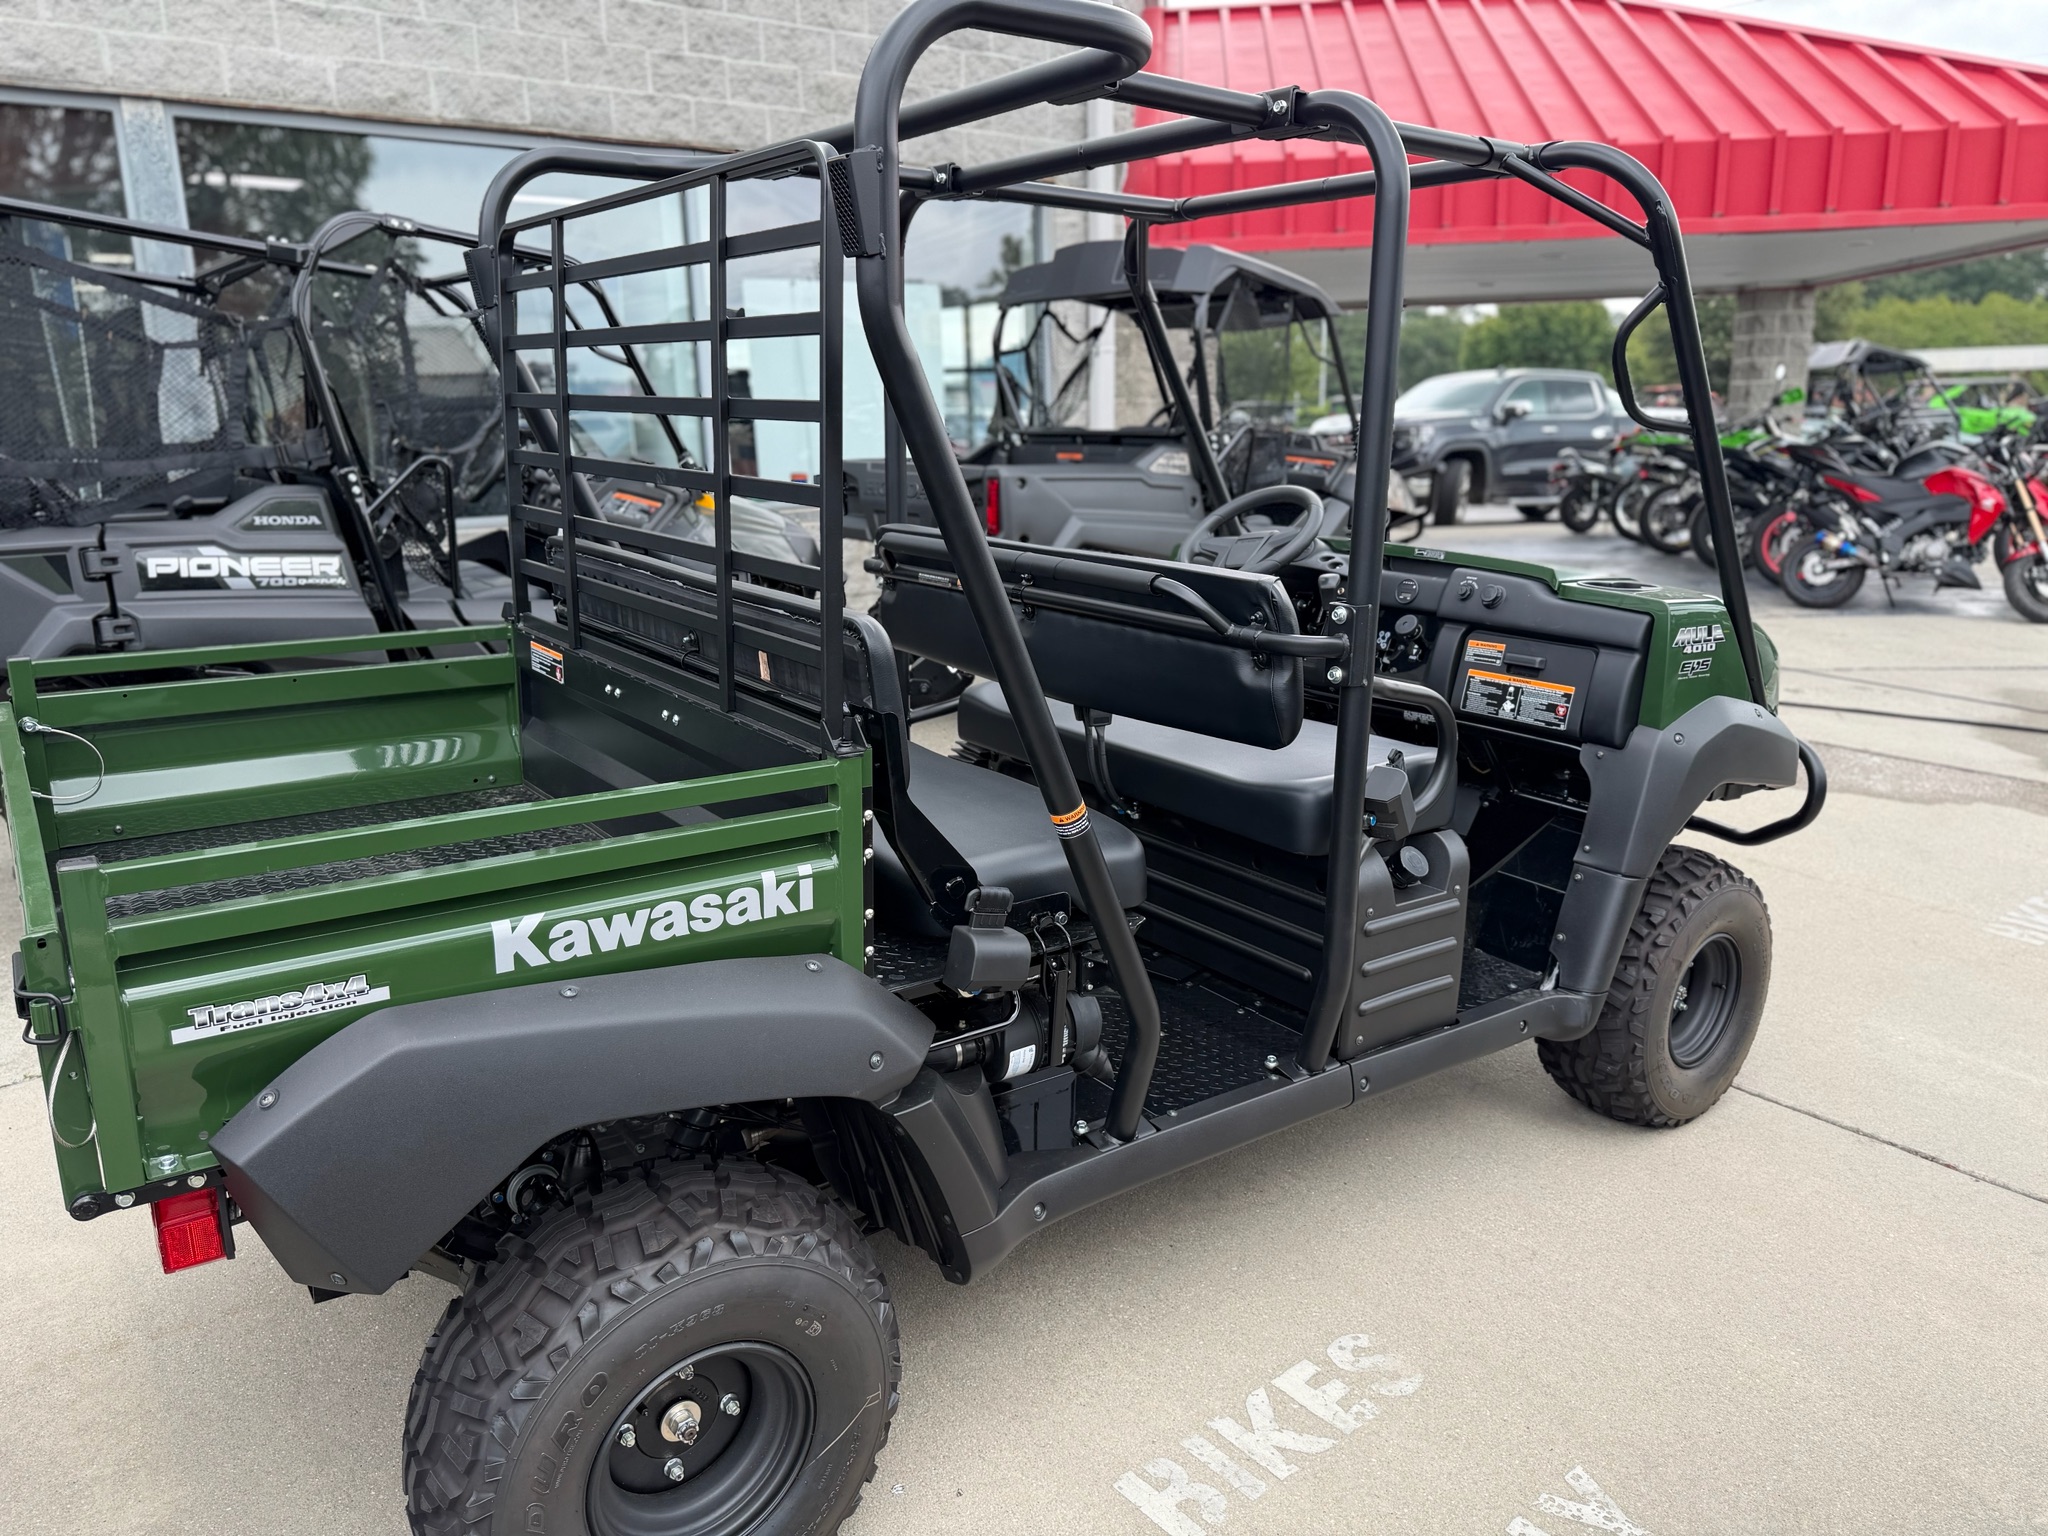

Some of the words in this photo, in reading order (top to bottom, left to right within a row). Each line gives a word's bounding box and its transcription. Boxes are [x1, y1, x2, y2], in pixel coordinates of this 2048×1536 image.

[253, 515, 322, 526] HONDA
[147, 556, 342, 579] PIONEER
[255, 577, 297, 587] 700
[1672, 624, 1726, 647] MULE
[1683, 643, 1716, 654] 4010
[1678, 658, 1712, 676] EPS
[490, 863, 814, 975] Kawasaki
[187, 974, 371, 1029] Trans4x4
[219, 1018, 263, 1032] Fuel
[270, 1000, 358, 1022] Injection
[1112, 1333, 1424, 1536] BIKES
[525, 1371, 609, 1534] DURO
